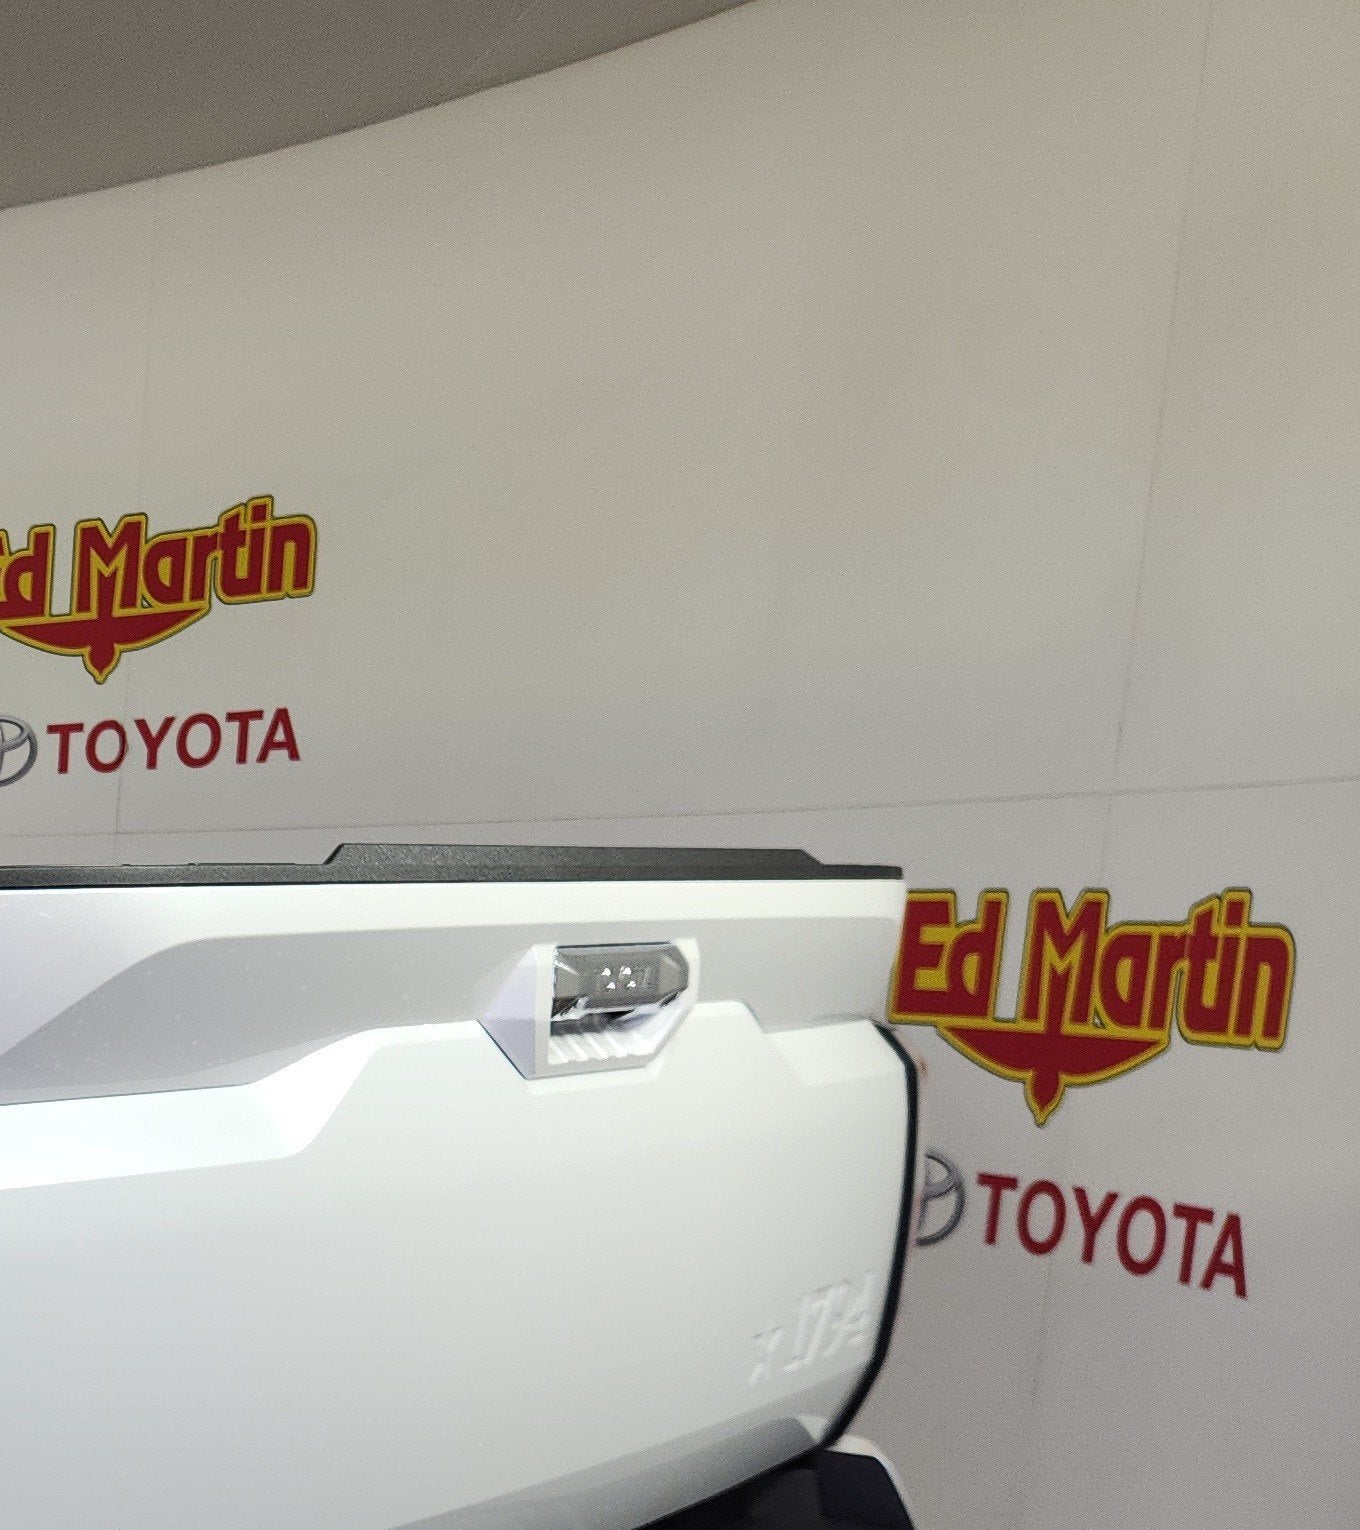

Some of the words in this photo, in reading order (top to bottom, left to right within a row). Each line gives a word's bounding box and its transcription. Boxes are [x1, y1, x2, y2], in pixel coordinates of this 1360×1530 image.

[74, 495, 317, 622] Martin
[47, 708, 301, 774] TOYOTA
[888, 888, 1009, 1025] Ed
[1016, 887, 1296, 1052] Martin
[977, 1172, 1247, 1299] TOYOTA
